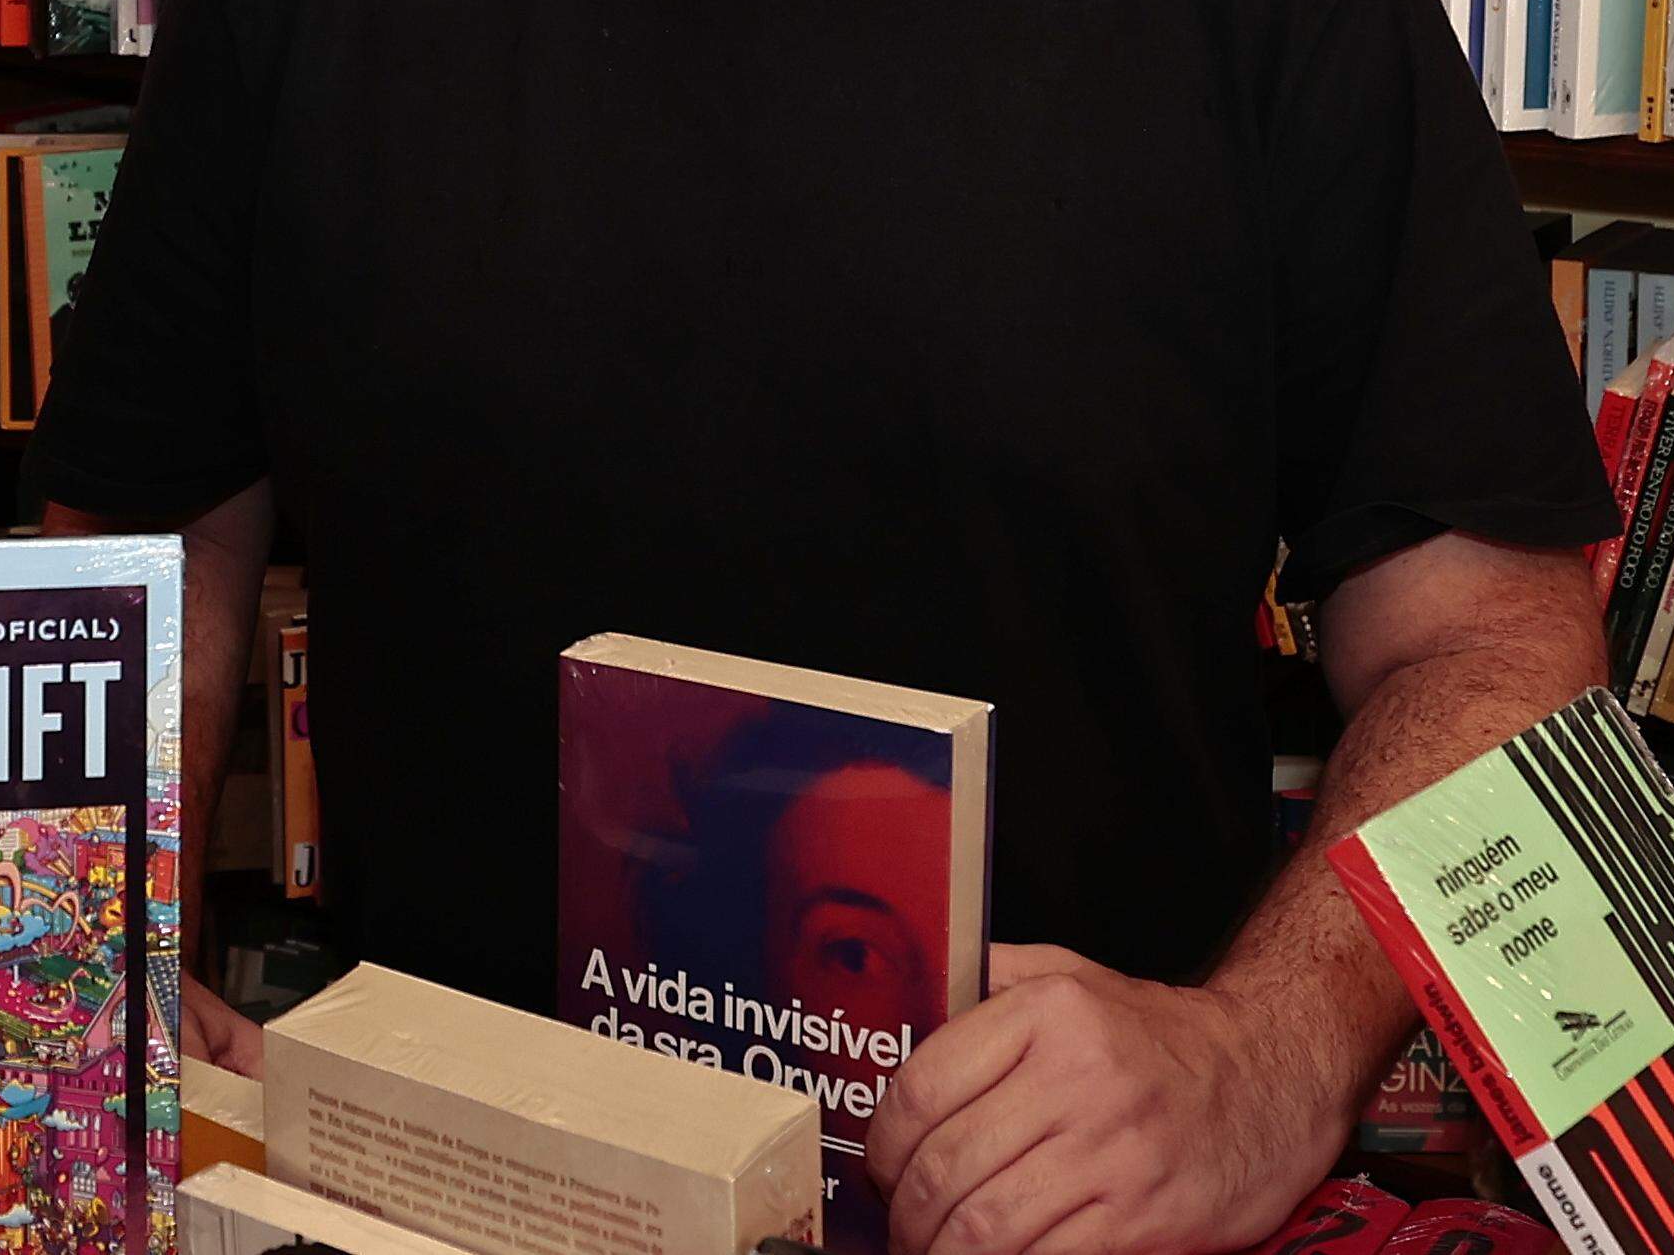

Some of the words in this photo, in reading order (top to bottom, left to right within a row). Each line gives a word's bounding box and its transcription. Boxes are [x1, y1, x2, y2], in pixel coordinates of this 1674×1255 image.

[1639, 458, 1667, 521] DENTRO
[1632, 522, 1649, 546] DO
[1619, 545, 1643, 588] FOGO
[1645, 545, 1670, 588] FOGO
[1435, 832, 1522, 898] ninguém
[1447, 903, 1500, 946] sabe
[1499, 895, 1516, 913] o
[1512, 861, 1560, 904] meu
[1499, 915, 1559, 966] nome
[580, 947, 615, 998] A
[621, 962, 715, 1024] vida
[723, 982, 913, 1068] invisível
[590, 1010, 645, 1048] da
[742, 1044, 900, 1119] Orwel
[1537, 1164, 1587, 1239] nome
